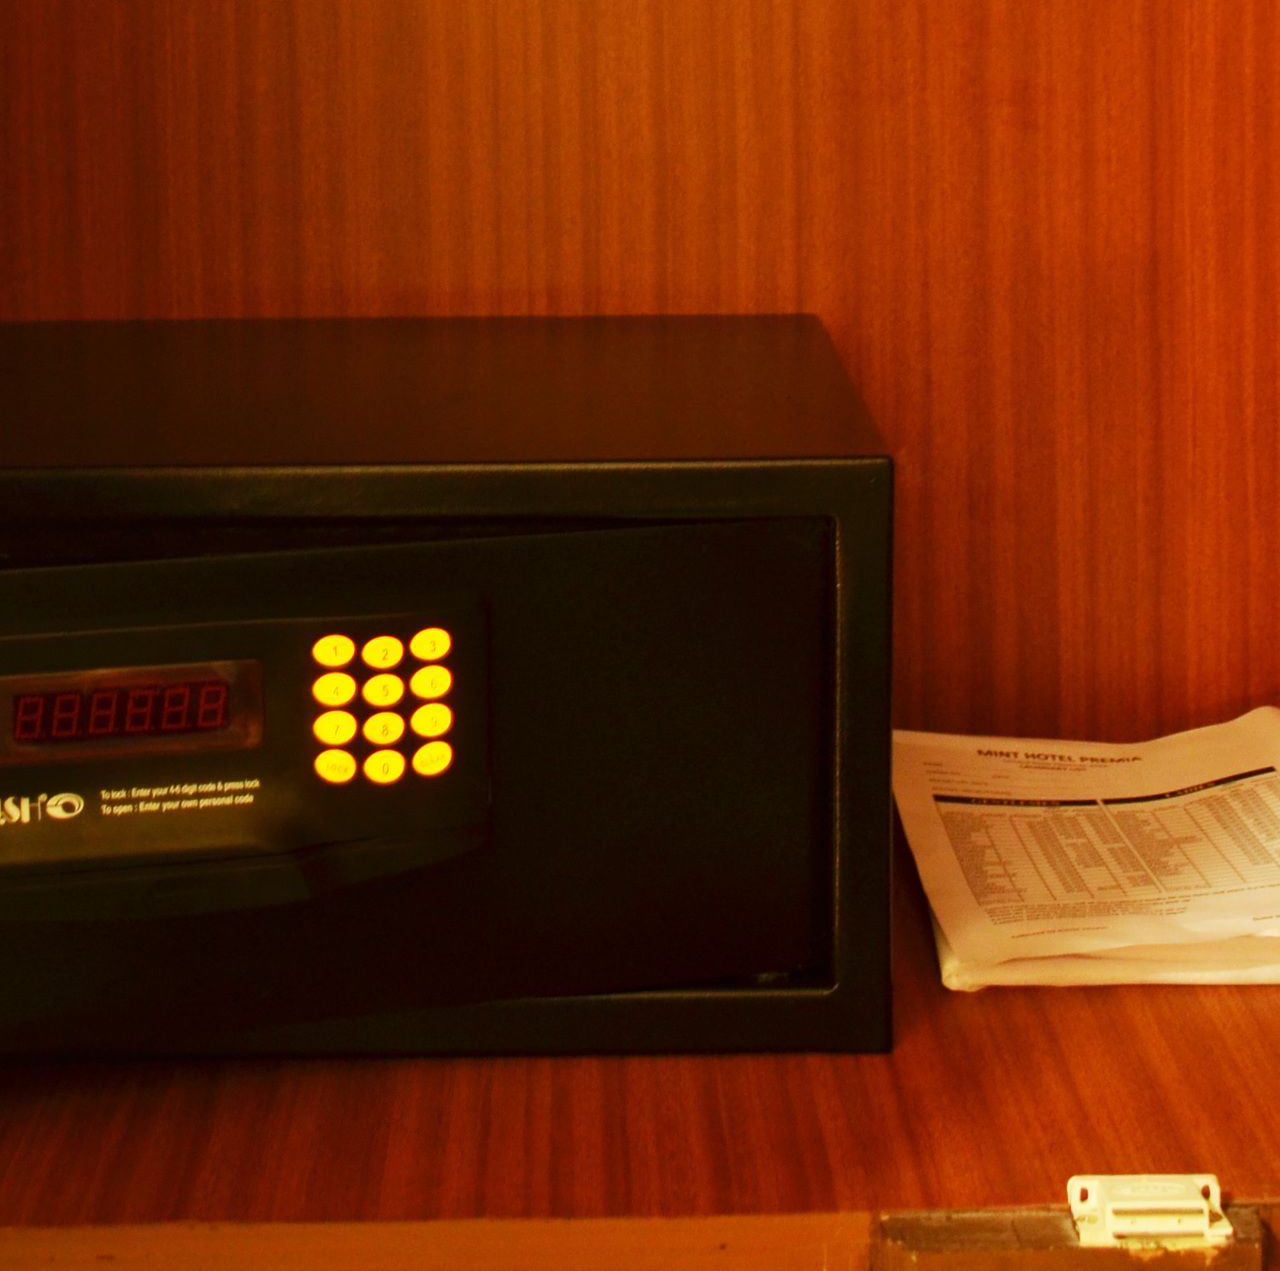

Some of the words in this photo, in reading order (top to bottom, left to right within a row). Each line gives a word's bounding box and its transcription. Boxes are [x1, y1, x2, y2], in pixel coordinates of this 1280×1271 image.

[977, 749, 1019, 759] MINT
[1024, 751, 1076, 763] HOTEL
[100, 789, 111, 800] To
[111, 788, 127, 800] lock
[131, 787, 151, 799] Enter
[151, 787, 169, 799] your
[181, 783, 198, 796] digit
[198, 782, 216, 793] code
[223, 781, 244, 793] press
[244, 778, 260, 790] lock
[101, 803, 112, 815] To
[112, 804, 133, 816] open
[139, 801, 160, 813] Enter
[161, 800, 180, 813] your
[180, 799, 198, 809] own
[199, 795, 234, 809] personal
[234, 793, 255, 805] code
